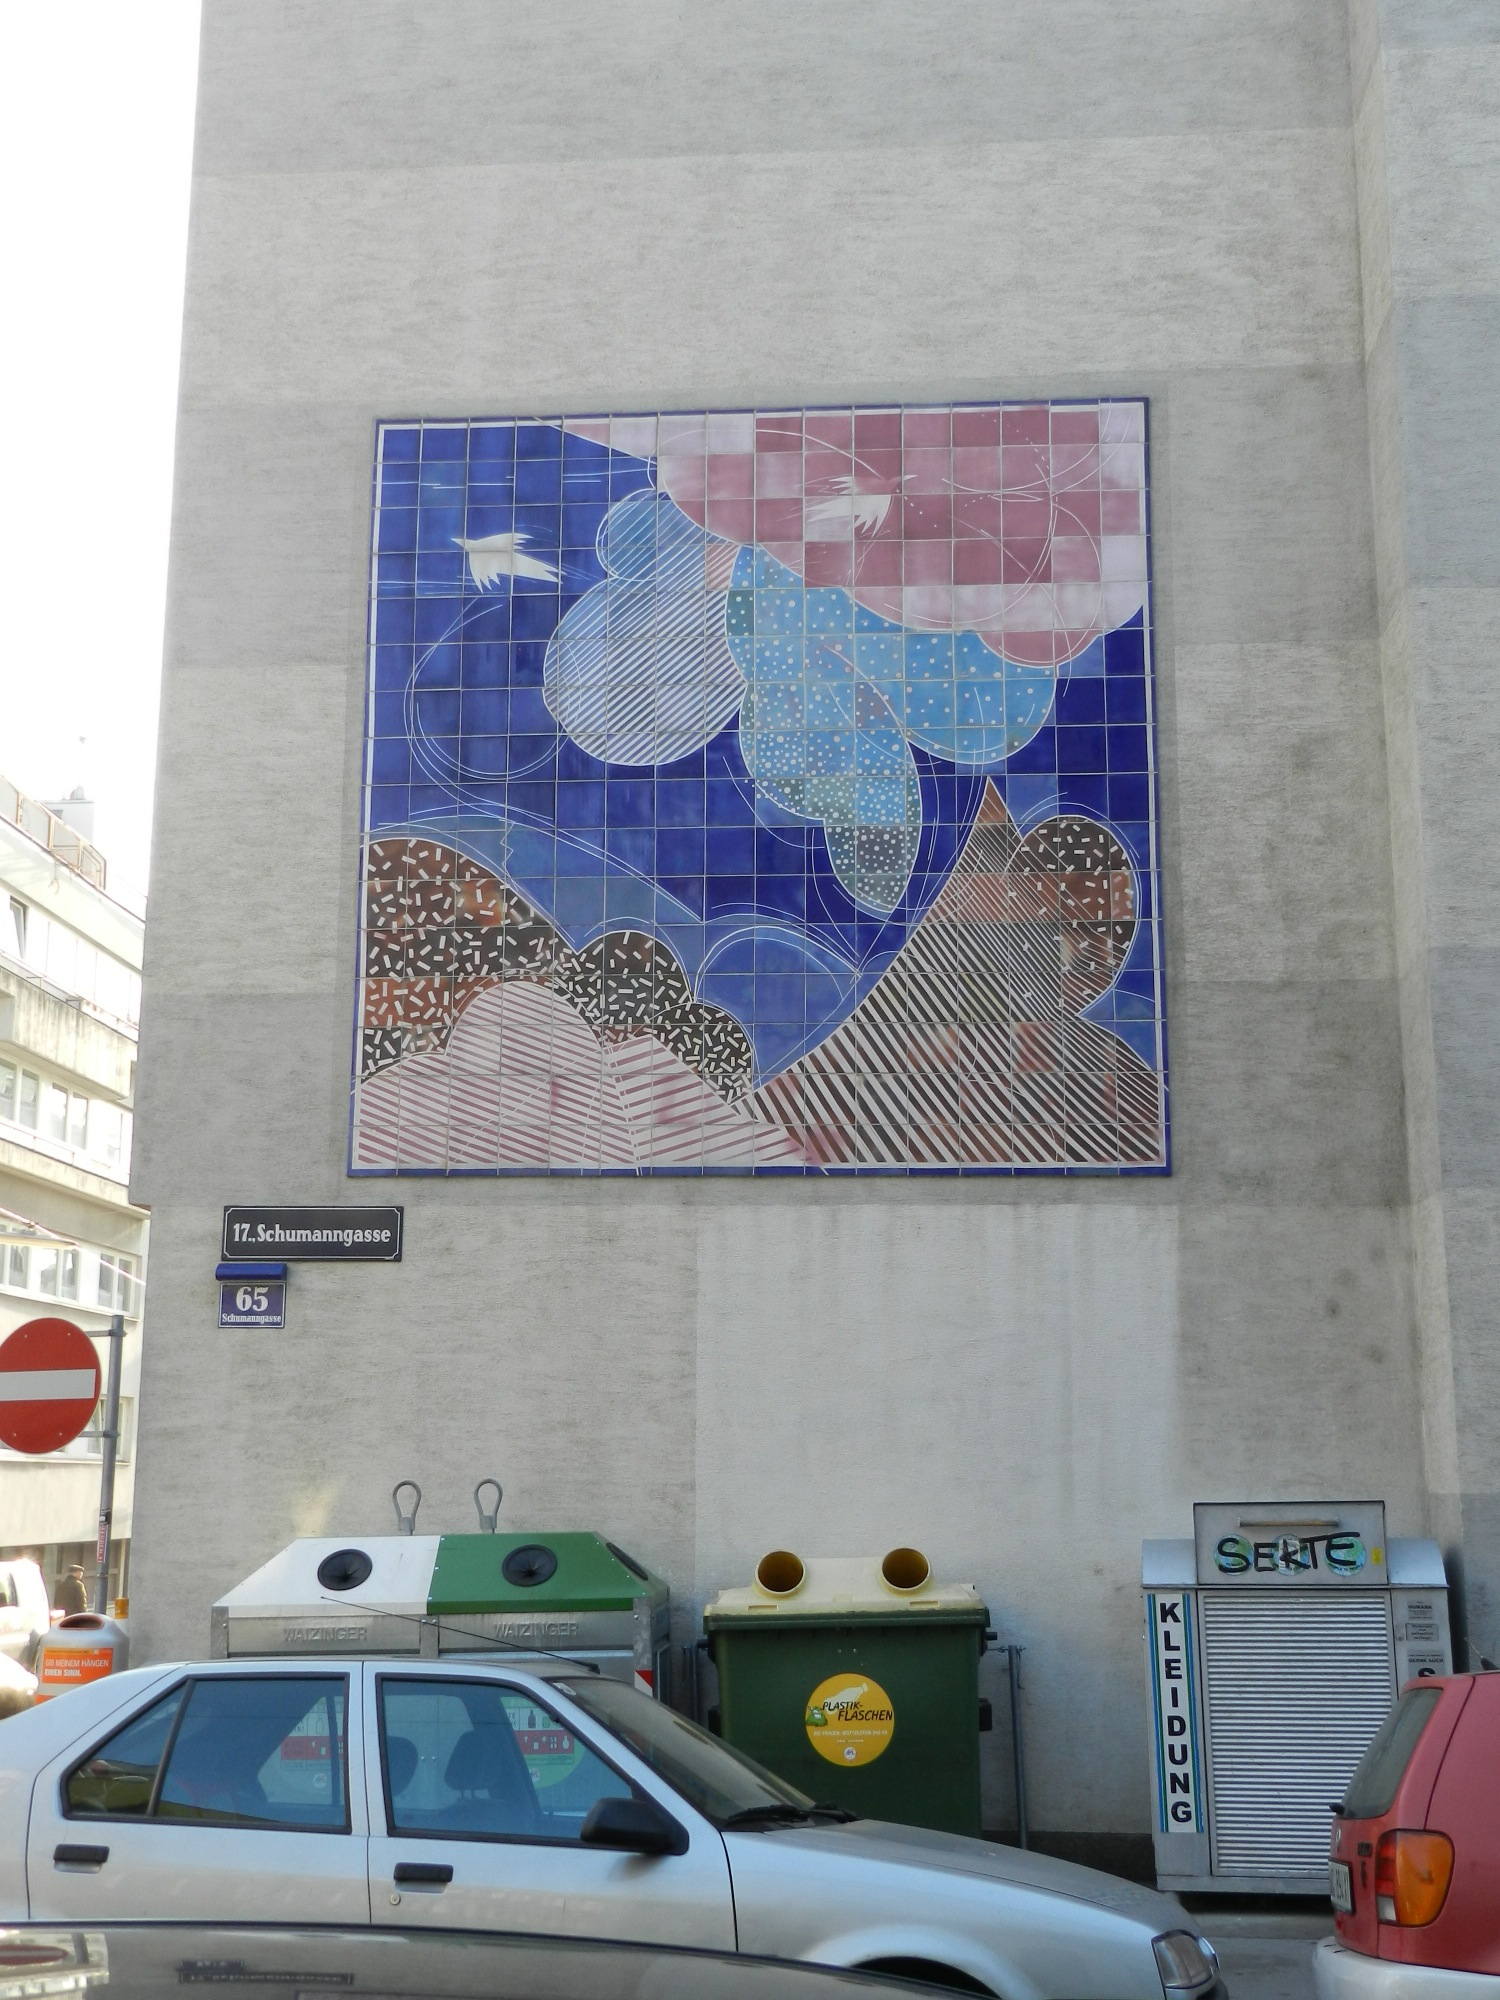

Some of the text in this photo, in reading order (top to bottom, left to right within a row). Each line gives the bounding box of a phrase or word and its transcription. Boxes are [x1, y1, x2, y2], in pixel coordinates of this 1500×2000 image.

[235, 1286, 269, 1312] 65
[222, 1313, 282, 1325] Schumanngasse
[284, 1627, 368, 1641] WAIZINGER
[495, 1623, 579, 1638] WAIZINGER
[838, 1709, 893, 1721] FLASCHEN
[1159, 1602, 1193, 1823] KLEIDUNG
